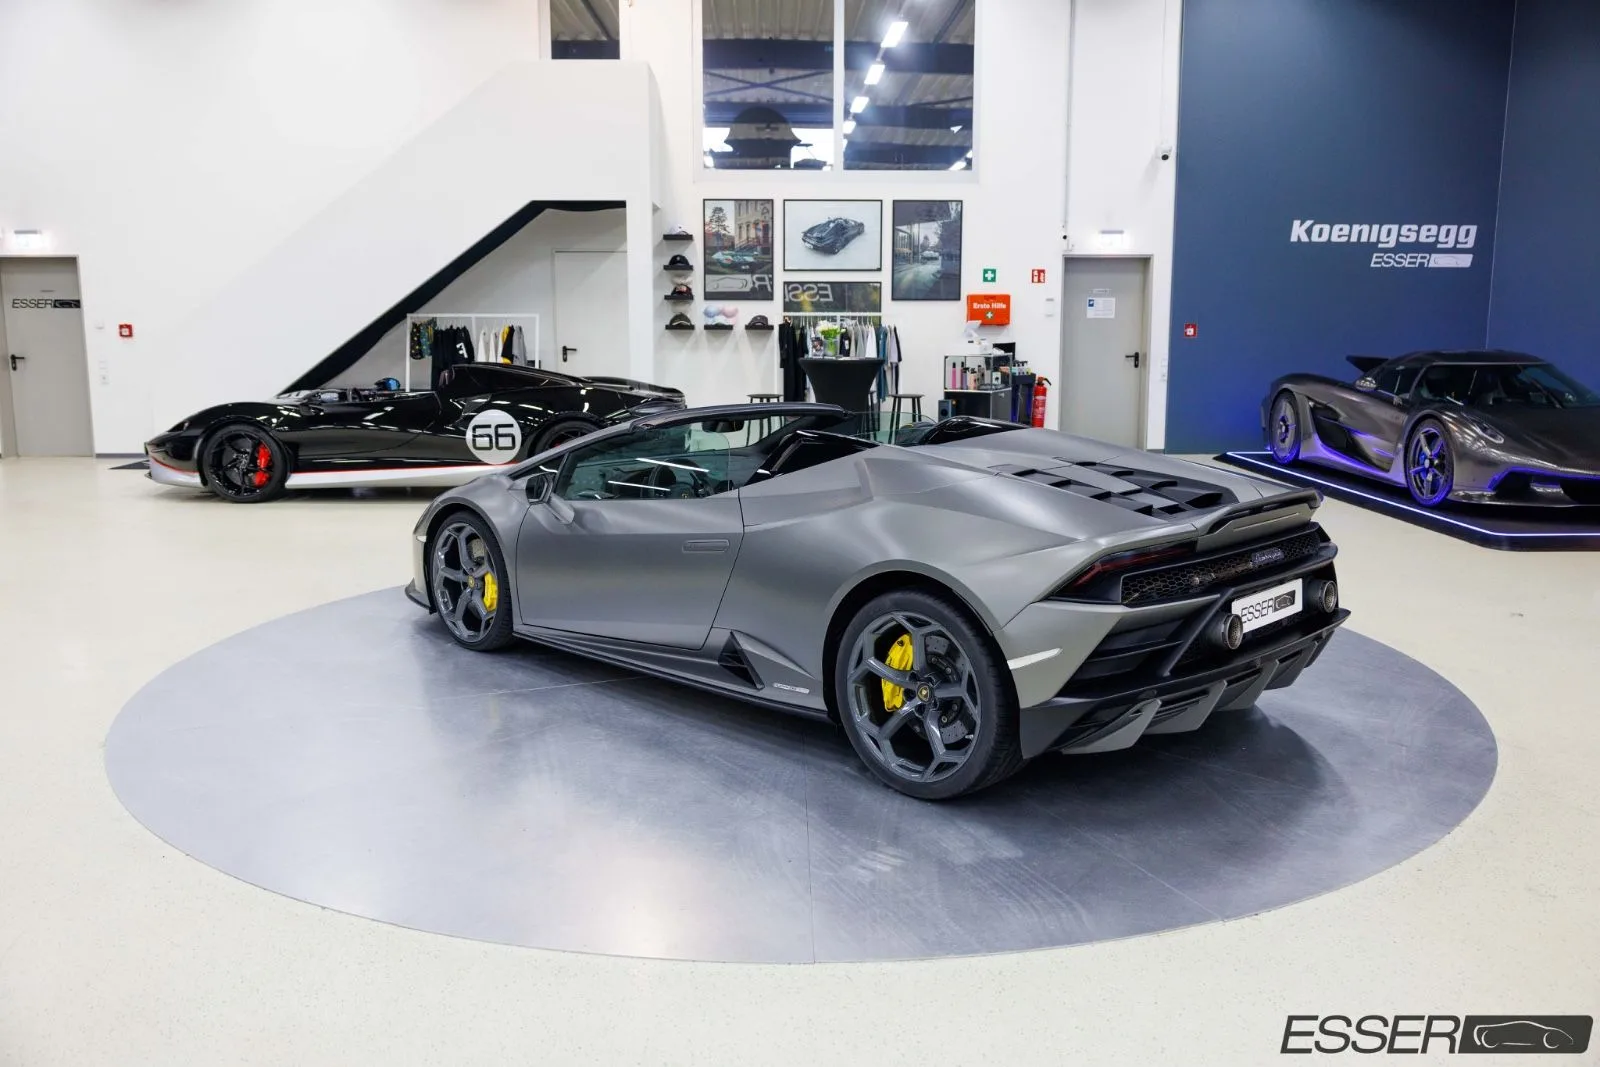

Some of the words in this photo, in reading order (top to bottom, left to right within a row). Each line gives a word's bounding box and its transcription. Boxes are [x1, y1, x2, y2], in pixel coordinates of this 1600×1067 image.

[1290, 219, 1478, 249] Koenigsegg
[1370, 253, 1430, 268] ESSER
[12, 299, 54, 309] ESSER
[472, 423, 516, 451] 66
[1240, 597, 1275, 624] ESSER
